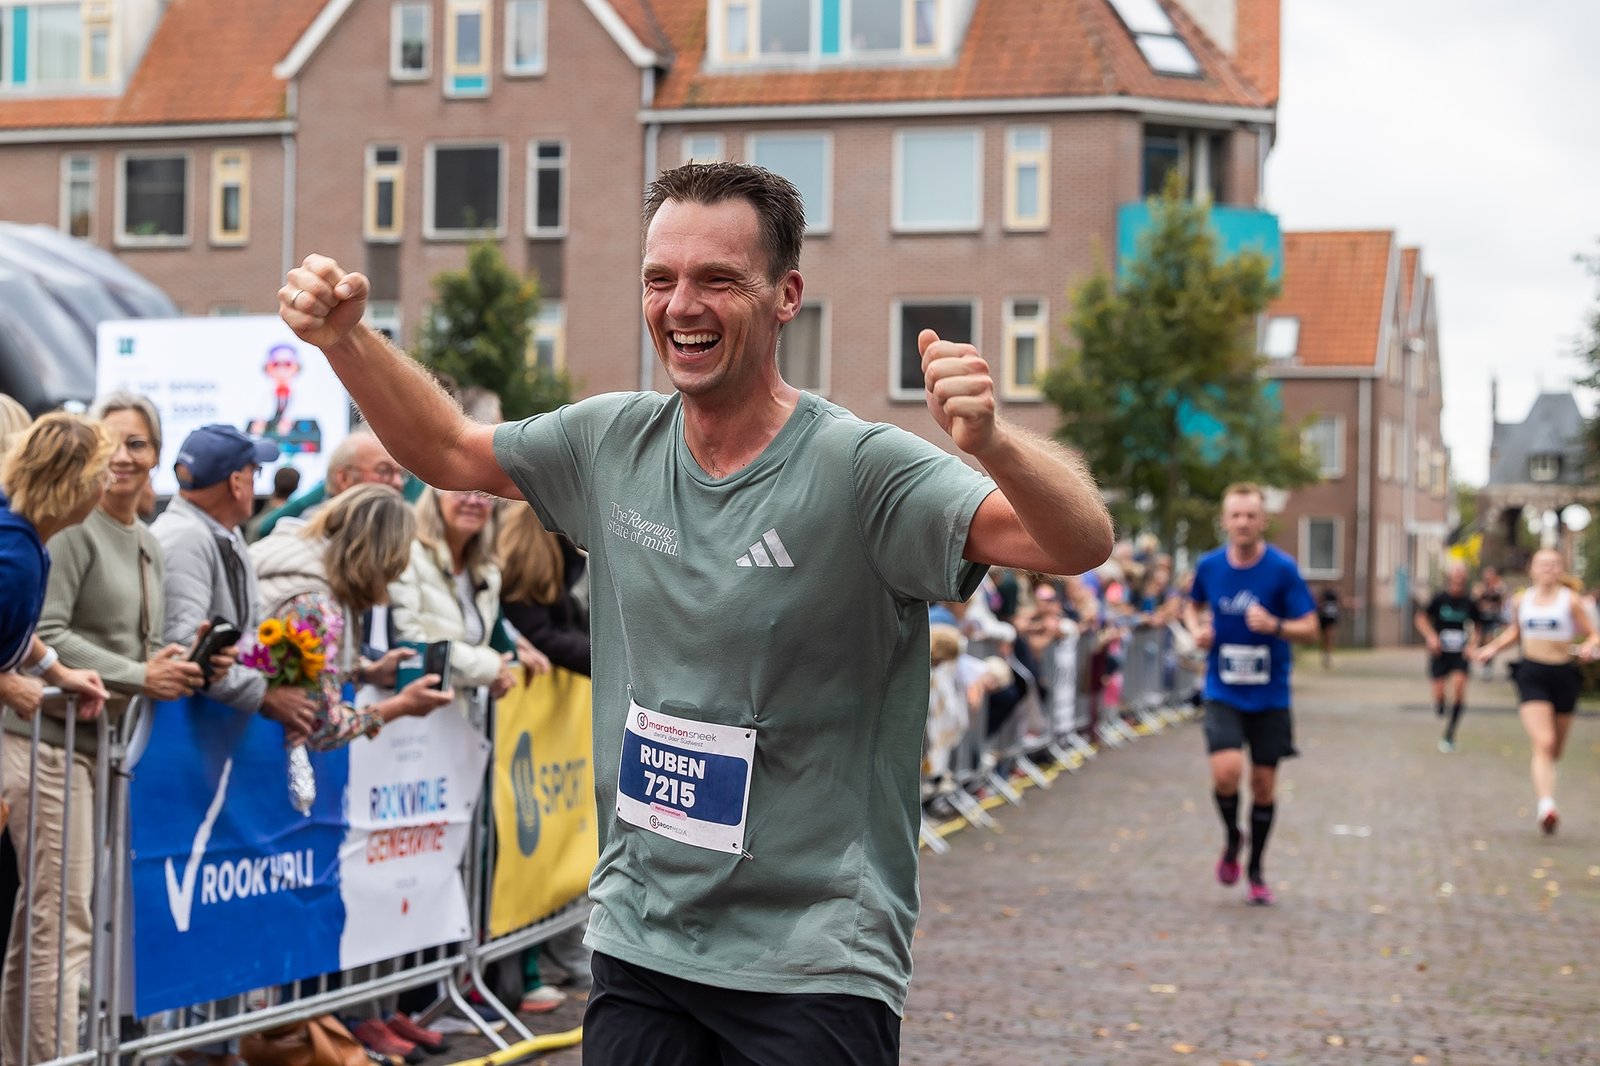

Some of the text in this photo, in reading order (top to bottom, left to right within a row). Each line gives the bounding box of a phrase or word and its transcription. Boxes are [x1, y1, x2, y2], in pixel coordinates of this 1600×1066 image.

[611, 501, 628, 523] The
[607, 520, 678, 556] state of mind.
[640, 744, 706, 779] RUBEN
[644, 771, 696, 808] 7215
[201, 848, 313, 905] ROOKVRIJ
